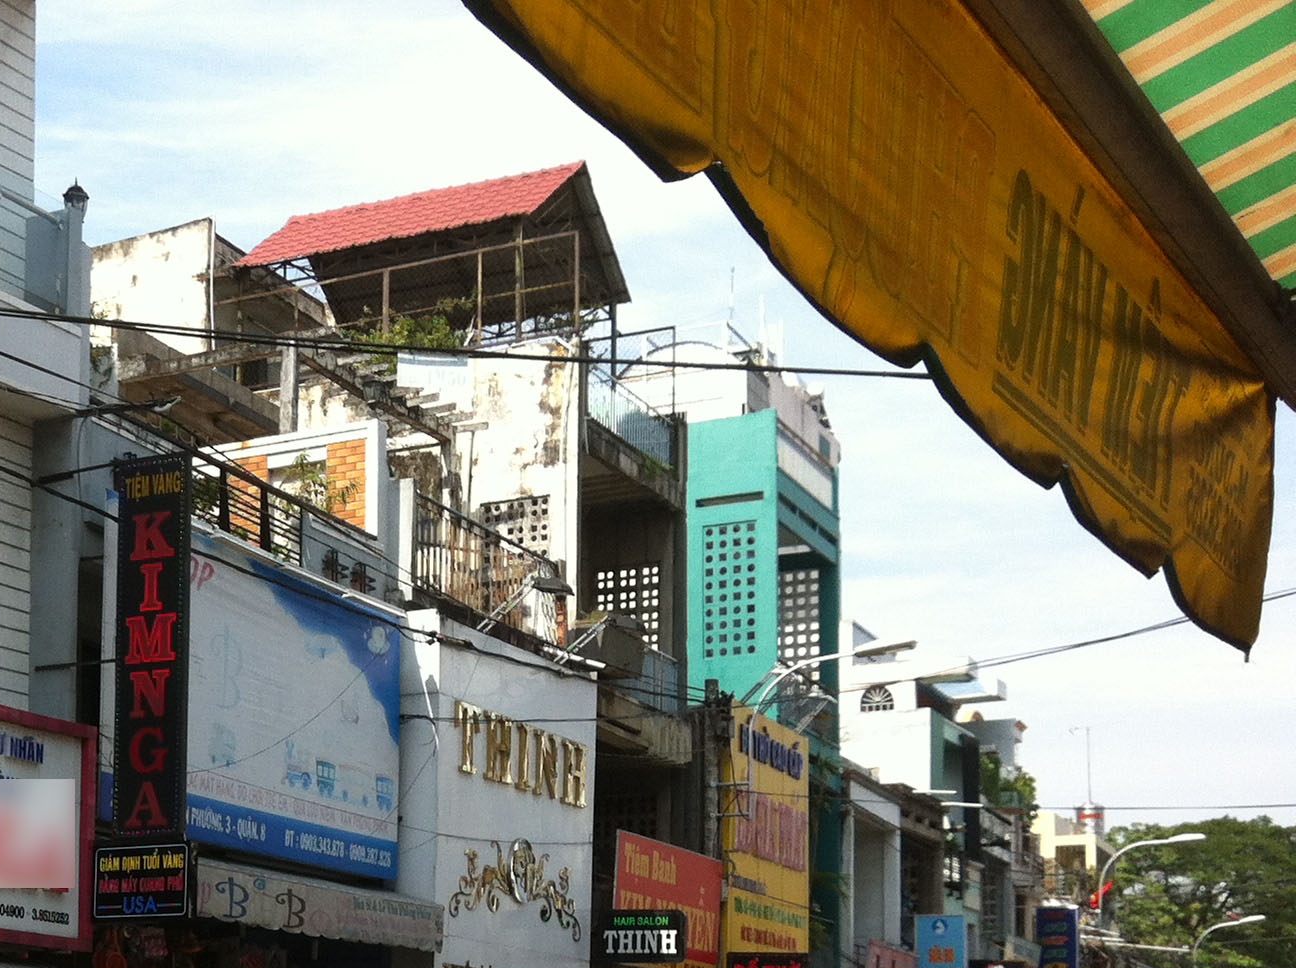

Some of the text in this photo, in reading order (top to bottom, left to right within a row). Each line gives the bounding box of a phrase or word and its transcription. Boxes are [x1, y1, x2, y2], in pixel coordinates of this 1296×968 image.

[10, 735, 45, 765] NHÂN
[455, 700, 589, 809] THINH
[162, 850, 184, 869] VÀNG
[123, 895, 157, 914] USA
[613, 916, 670, 927] HAIR SALON
[603, 929, 678, 955] THINH
